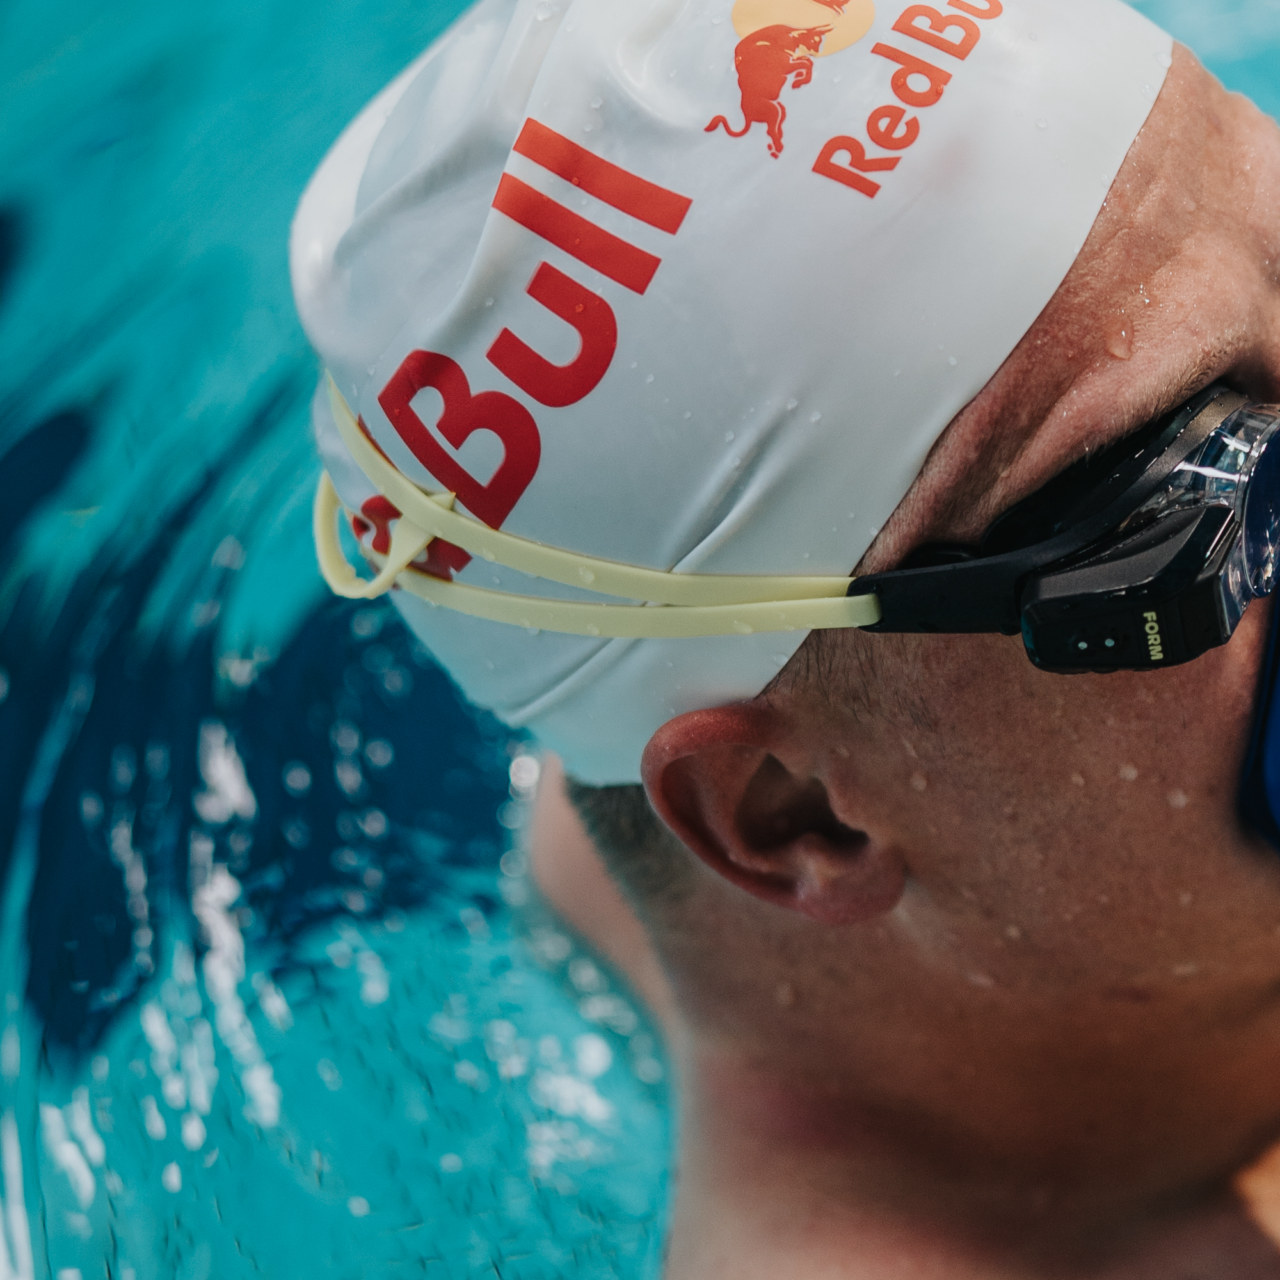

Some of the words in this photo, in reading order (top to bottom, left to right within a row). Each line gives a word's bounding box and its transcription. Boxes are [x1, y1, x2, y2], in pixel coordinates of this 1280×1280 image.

[811, 41, 953, 199] Red
[376, 116, 694, 532] Bull
[1142, 610, 1164, 661] FORM
